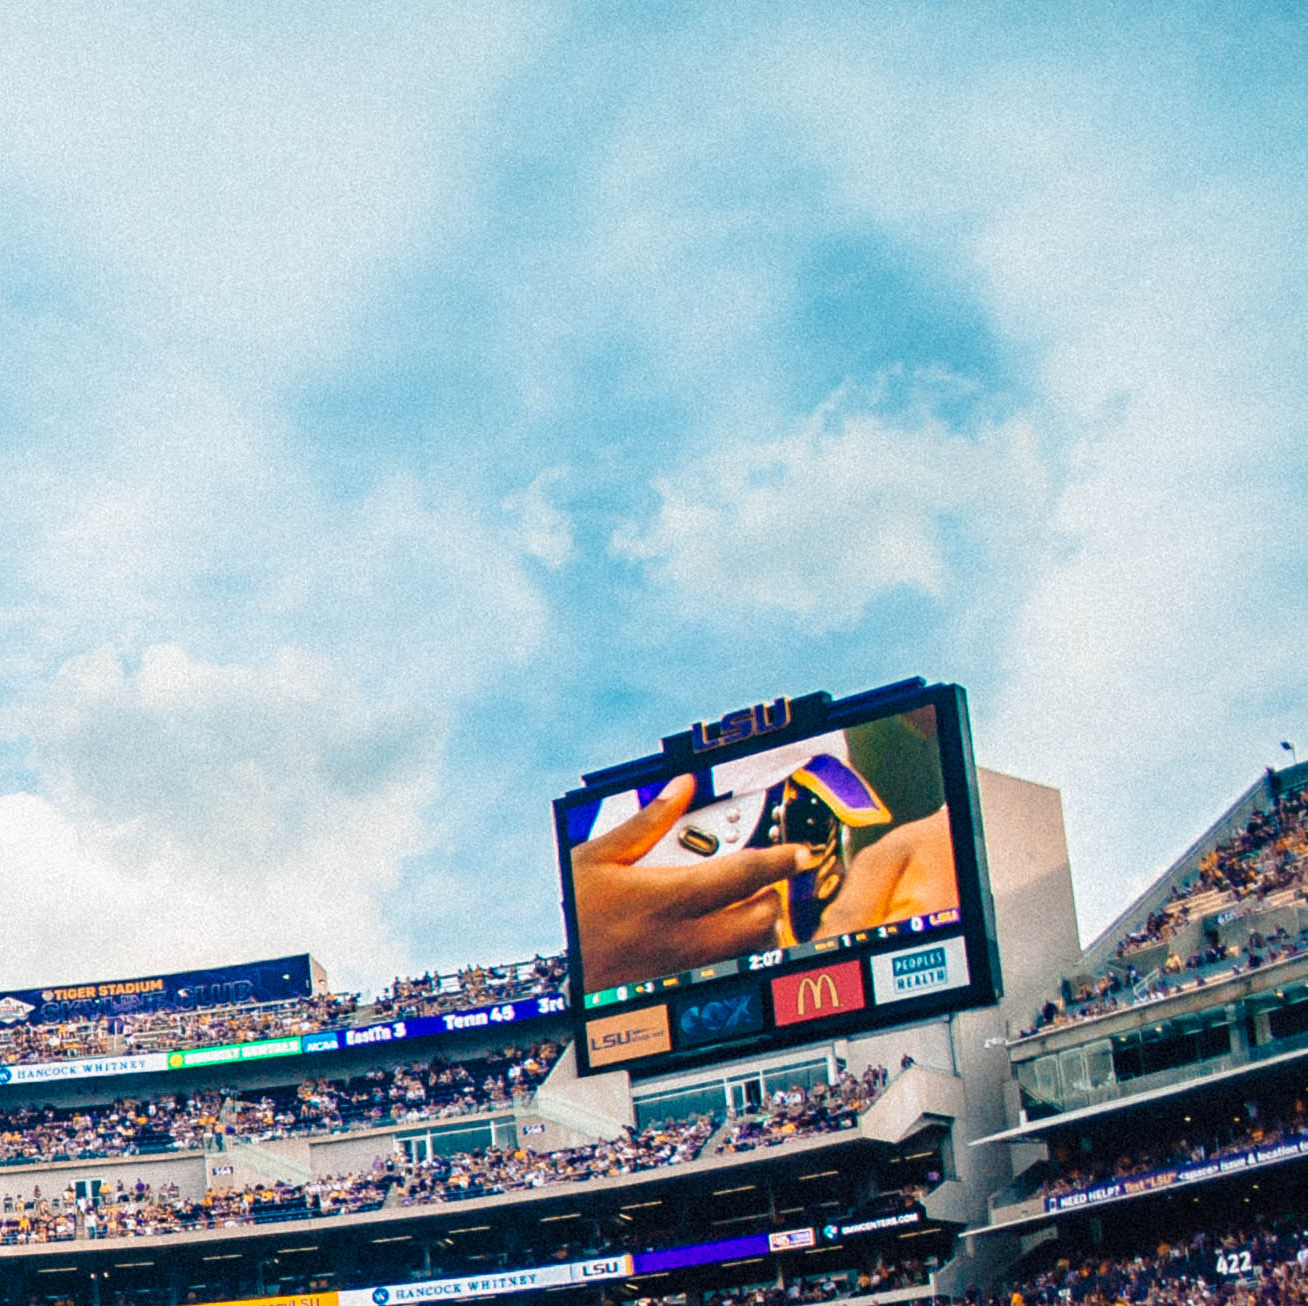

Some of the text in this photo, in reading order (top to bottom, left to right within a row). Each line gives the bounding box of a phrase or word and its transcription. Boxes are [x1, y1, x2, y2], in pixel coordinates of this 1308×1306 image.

[691, 696, 792, 754] LSU
[929, 910, 959, 925] LSU
[748, 949, 784, 971] 2:07
[894, 951, 944, 972] PEOPLES
[54, 978, 164, 1001] TIGER STADIUM
[896, 969, 946, 991] HEALTH
[442, 1005, 516, 1030] Tenn 45
[393, 1022, 407, 1038] 3
[307, 1039, 339, 1053] NCAA
[18, 1060, 147, 1080] HANCOCK WHITNEY
[1060, 1193, 1087, 1209] NEED
[1088, 1185, 1121, 1203] HELP?
[1257, 1145, 1300, 1163] location
[582, 1261, 619, 1277] LSU
[1215, 1250, 1252, 1276] 422
[396, 1273, 537, 1300] HANCOCK WHITNEY
